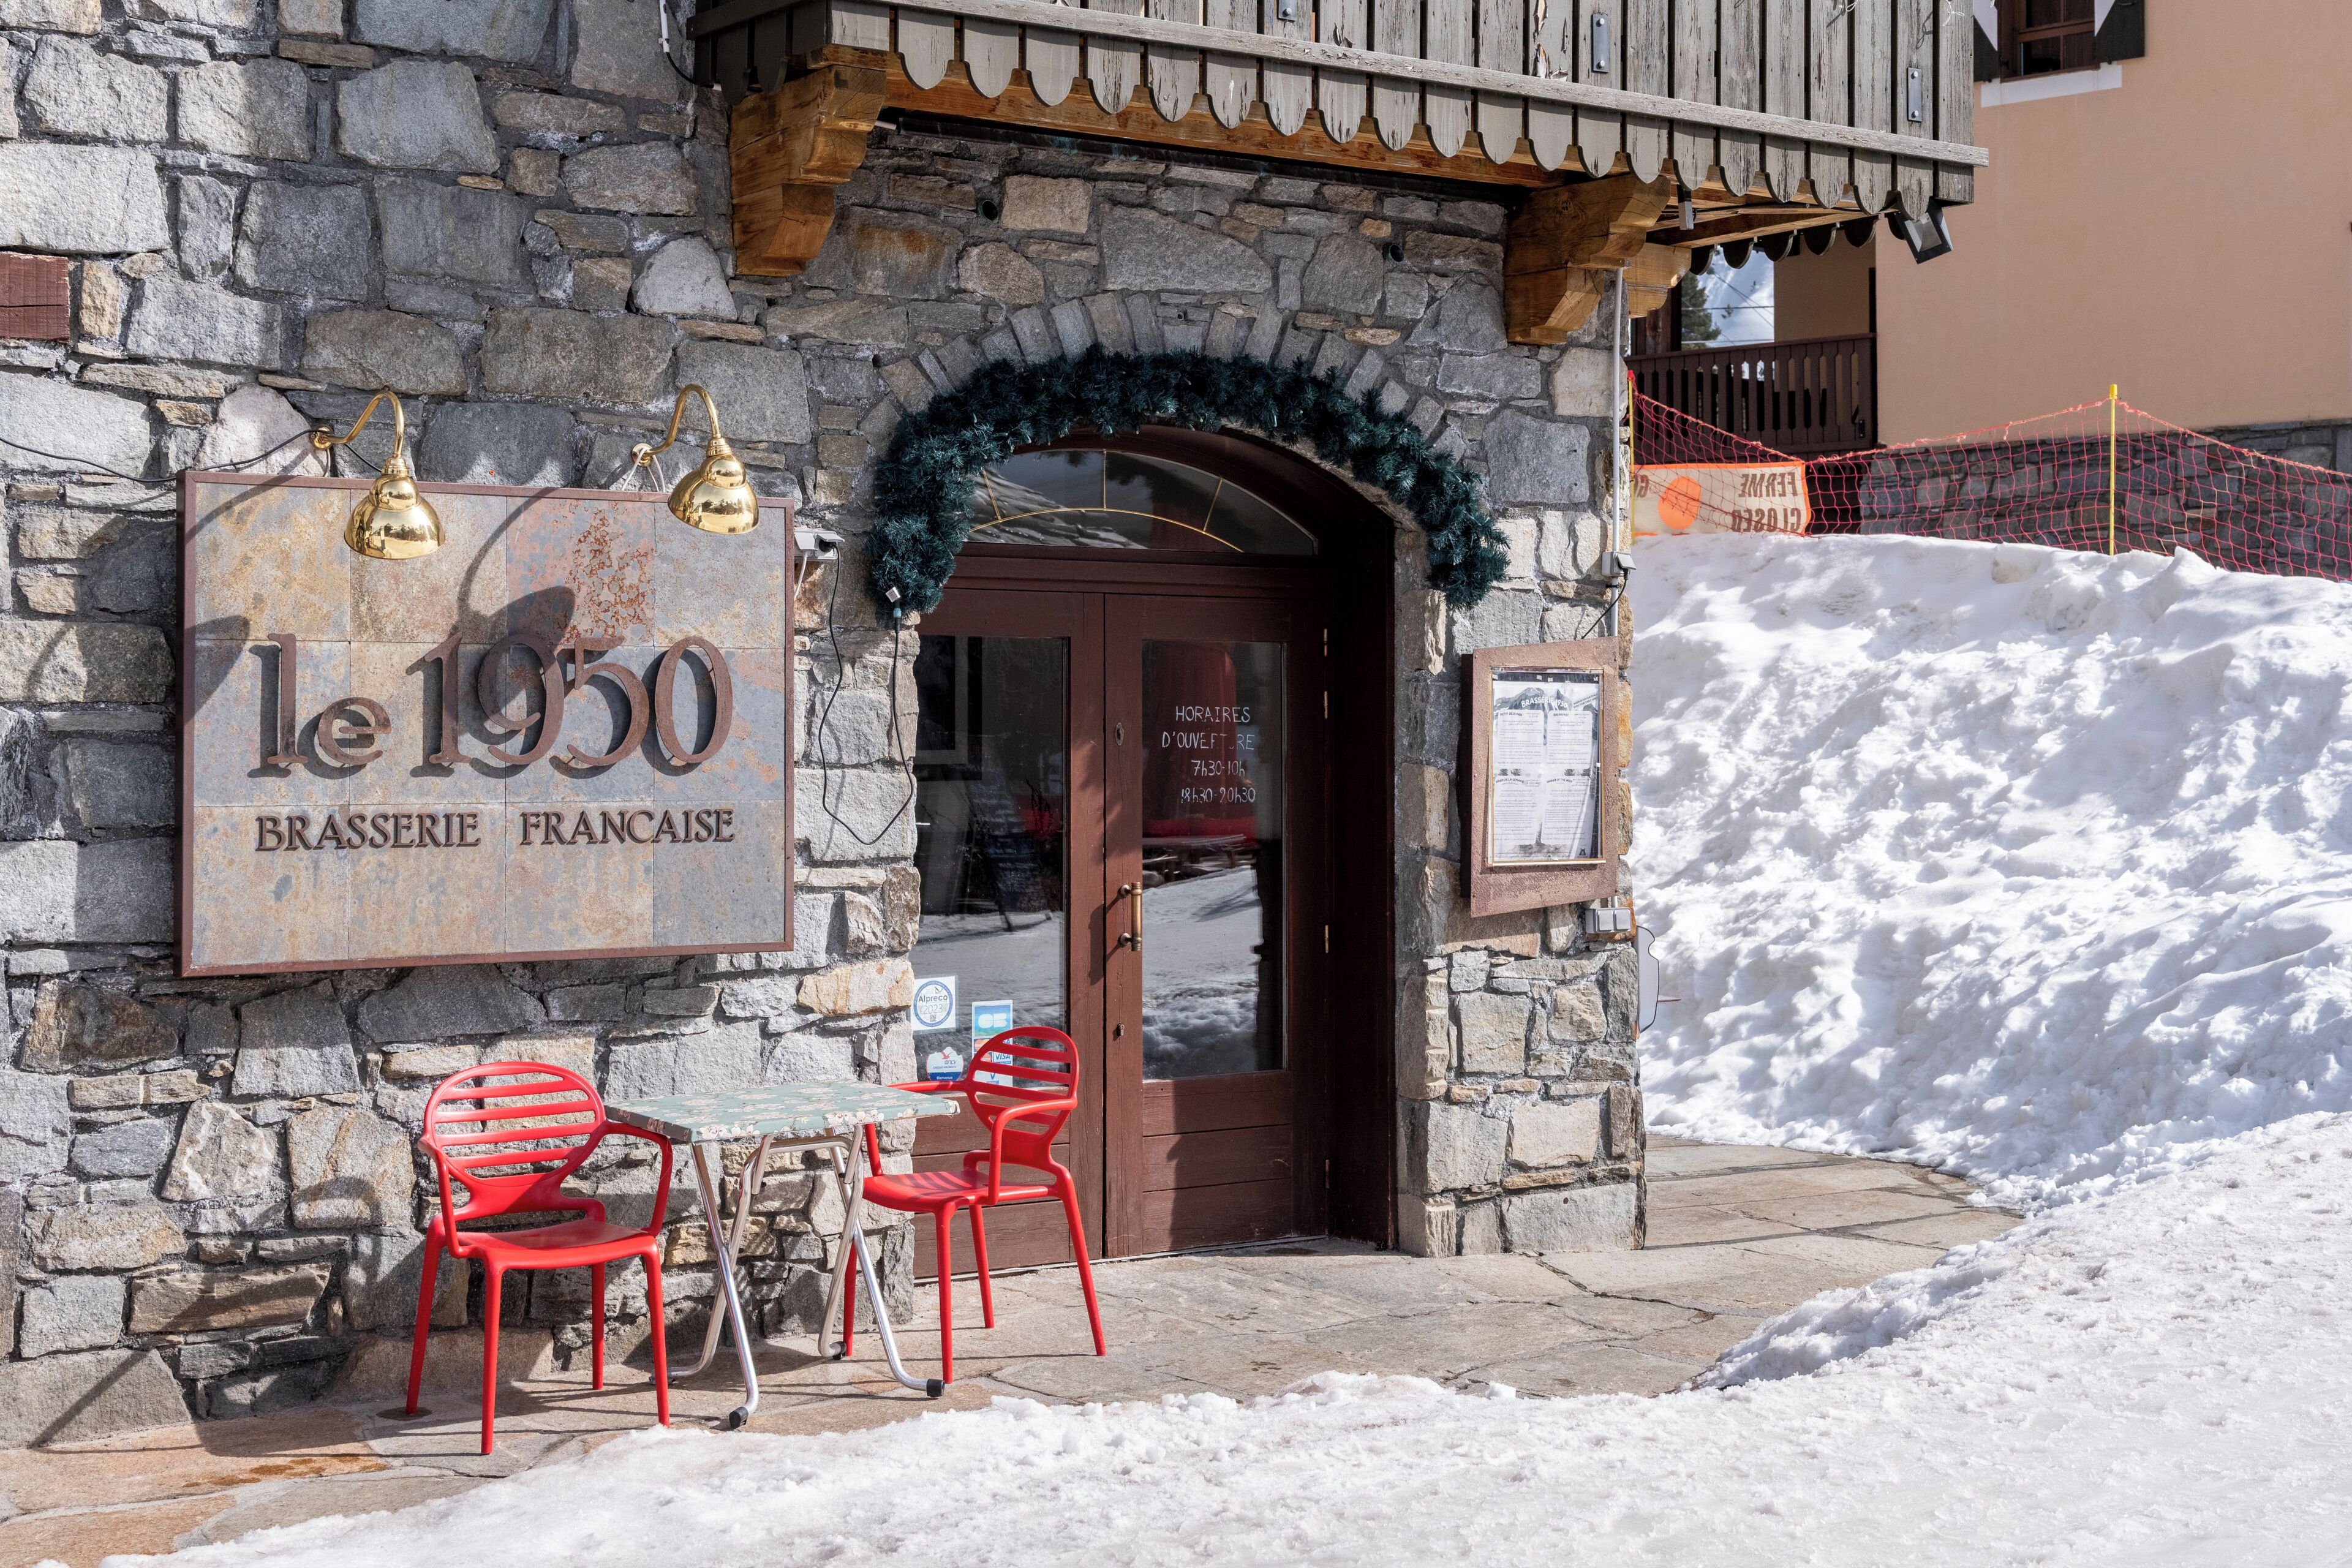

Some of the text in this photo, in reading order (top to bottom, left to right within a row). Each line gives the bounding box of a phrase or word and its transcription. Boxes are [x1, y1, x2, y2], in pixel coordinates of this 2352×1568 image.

[267, 632, 733, 766] le 1950
[1175, 706, 1251, 723] HORAIRES
[257, 808, 735, 852] BRASSERIE FRANCAISE
[918, 995, 948, 1004] Alpreco
[923, 1004, 943, 1014] 2023
